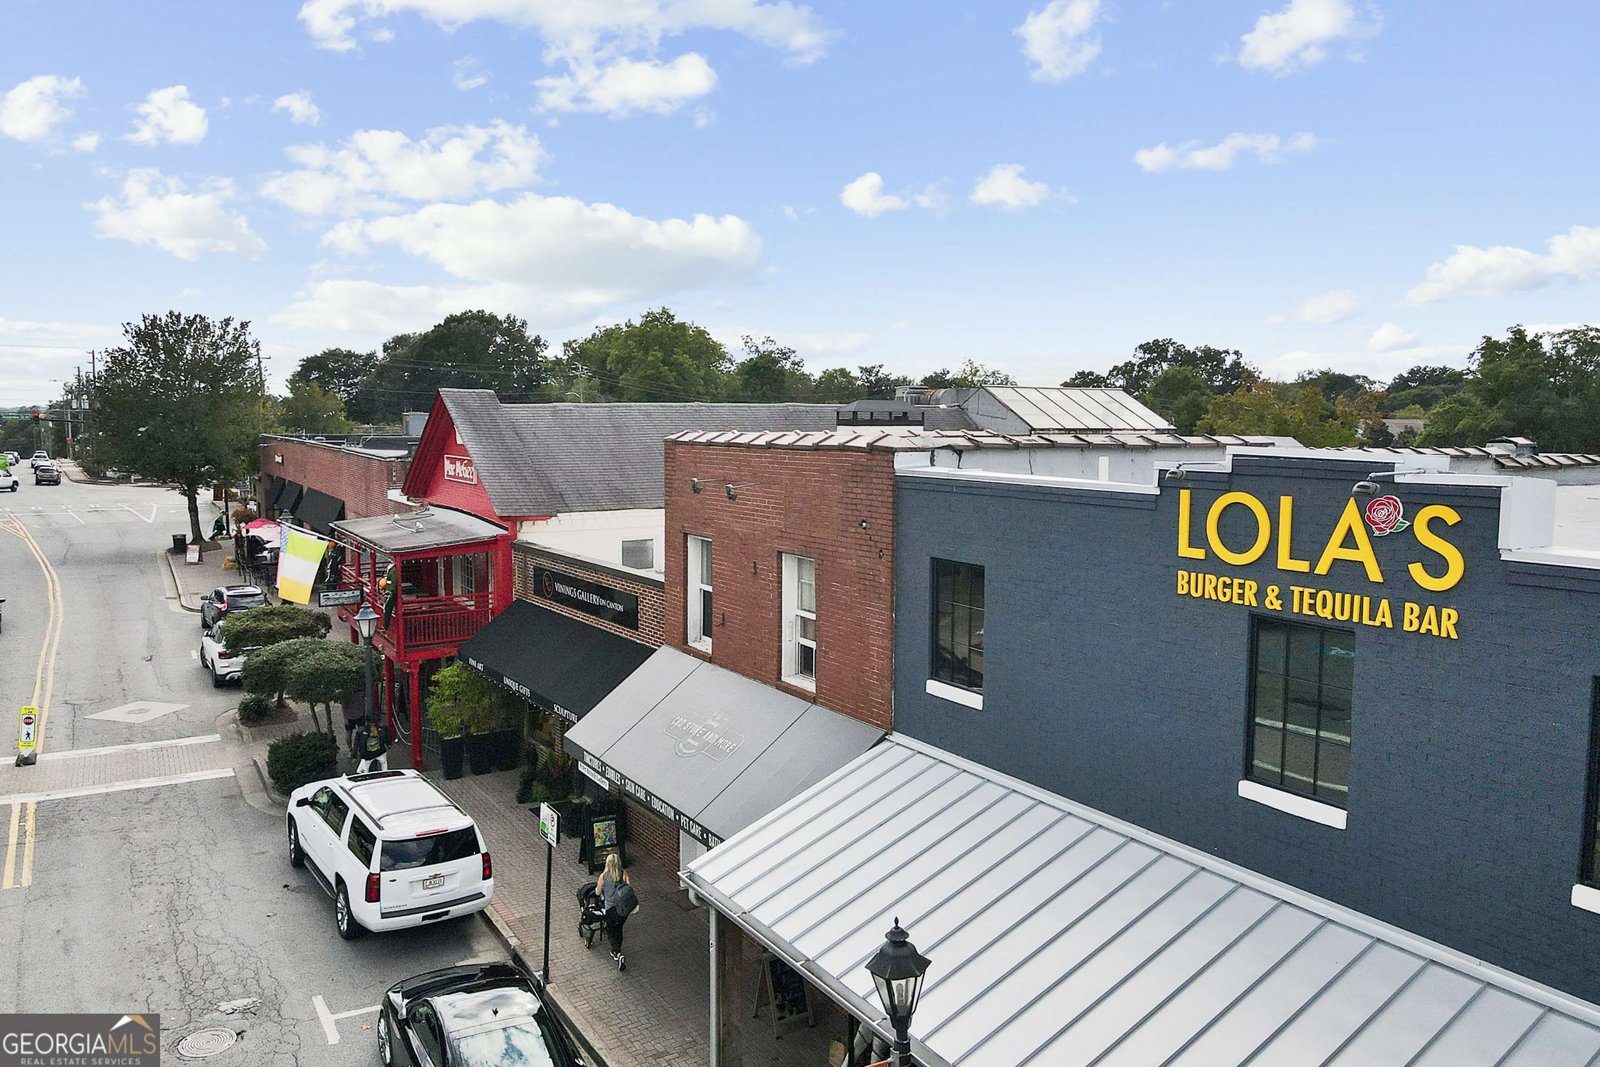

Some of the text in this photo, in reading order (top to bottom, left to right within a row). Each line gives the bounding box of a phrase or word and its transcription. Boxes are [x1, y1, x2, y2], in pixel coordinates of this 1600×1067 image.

[554, 582, 577, 598] VININGS
[577, 589, 600, 605] GALLERY
[606, 600, 624, 612] CANTON
[1177, 570, 1459, 639] BURGER & TEQUILA BAR
[503, 675, 531, 698] UNIQUE GIFTS
[553, 703, 578, 724] SCULPTURE
[683, 721, 706, 737] STORE
[701, 730, 718, 743] AND
[714, 737, 737, 753] MORE
[605, 766, 621, 786] EDIBLES
[625, 778, 635, 795] SKIN
[635, 784, 646, 802] CARE
[651, 795, 675, 821] EDUCATION
[680, 814, 689, 831] PET
[689, 820, 702, 840] CARE
